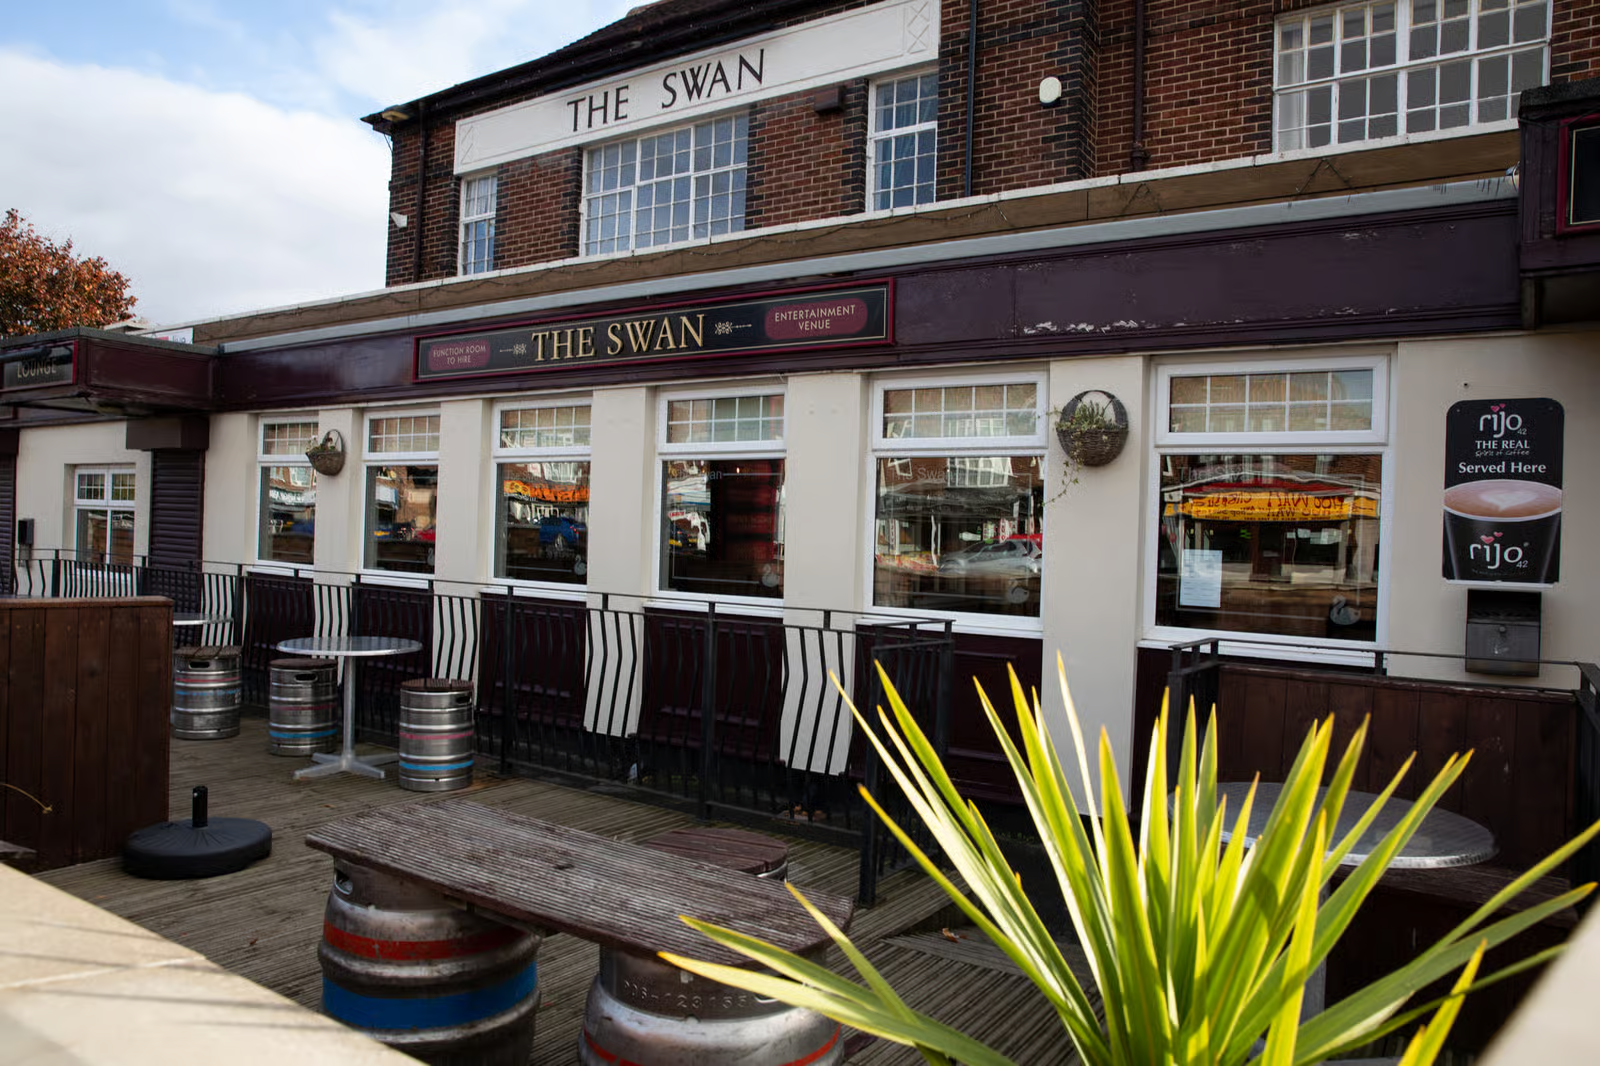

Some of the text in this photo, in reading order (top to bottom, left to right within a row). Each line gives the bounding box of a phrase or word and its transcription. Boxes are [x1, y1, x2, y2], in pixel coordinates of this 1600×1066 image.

[567, 48, 765, 132] THE SWAN
[774, 304, 856, 322] ENTERTAINMENT
[798, 319, 831, 332] VENUE
[532, 313, 705, 362] THE SWAN
[433, 344, 487, 358] FUNCTION ROOM
[446, 354, 472, 366] TO HIRE
[17, 357, 57, 379] LOUNGE
[1479, 409, 1528, 439] rijo 42
[1475, 439, 1530, 449] THE REAL
[1458, 460, 1547, 474] Served Here
[1469, 542, 1529, 570] rijo 42
